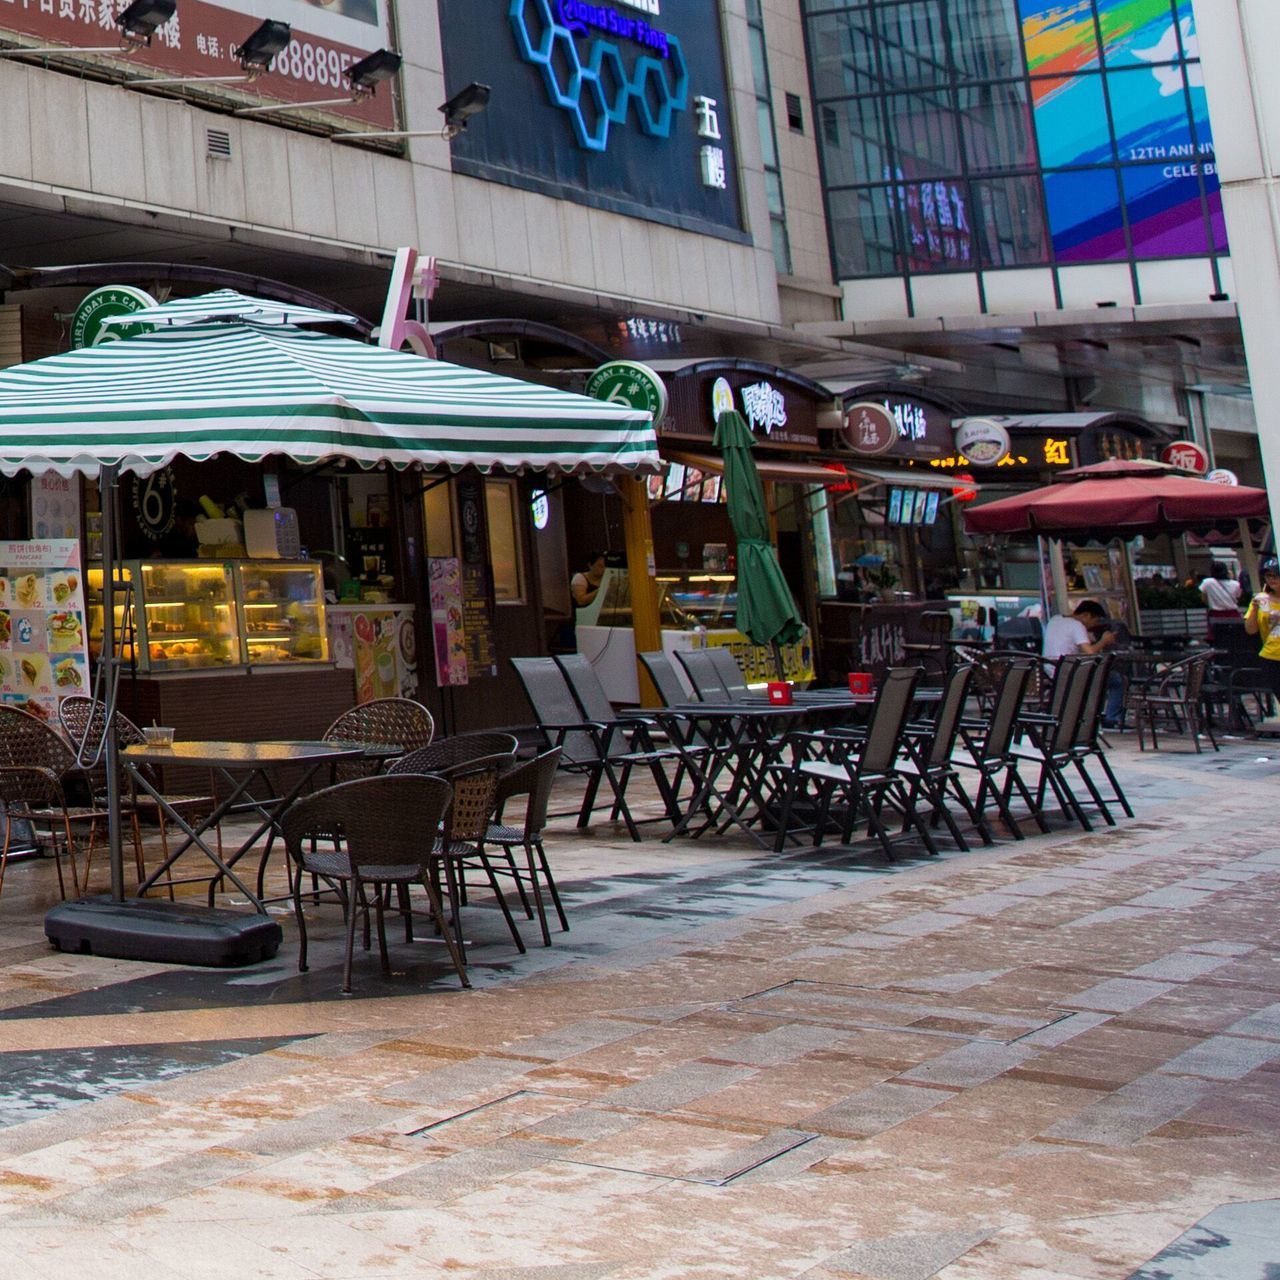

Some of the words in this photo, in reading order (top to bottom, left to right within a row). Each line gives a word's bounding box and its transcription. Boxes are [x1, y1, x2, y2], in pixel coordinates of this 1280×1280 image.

[694, 95, 727, 190] 五楼
[1130, 146, 1166, 160] 12TH
[1163, 162, 1218, 178] CELEB
[629, 369, 654, 391] CAKE
